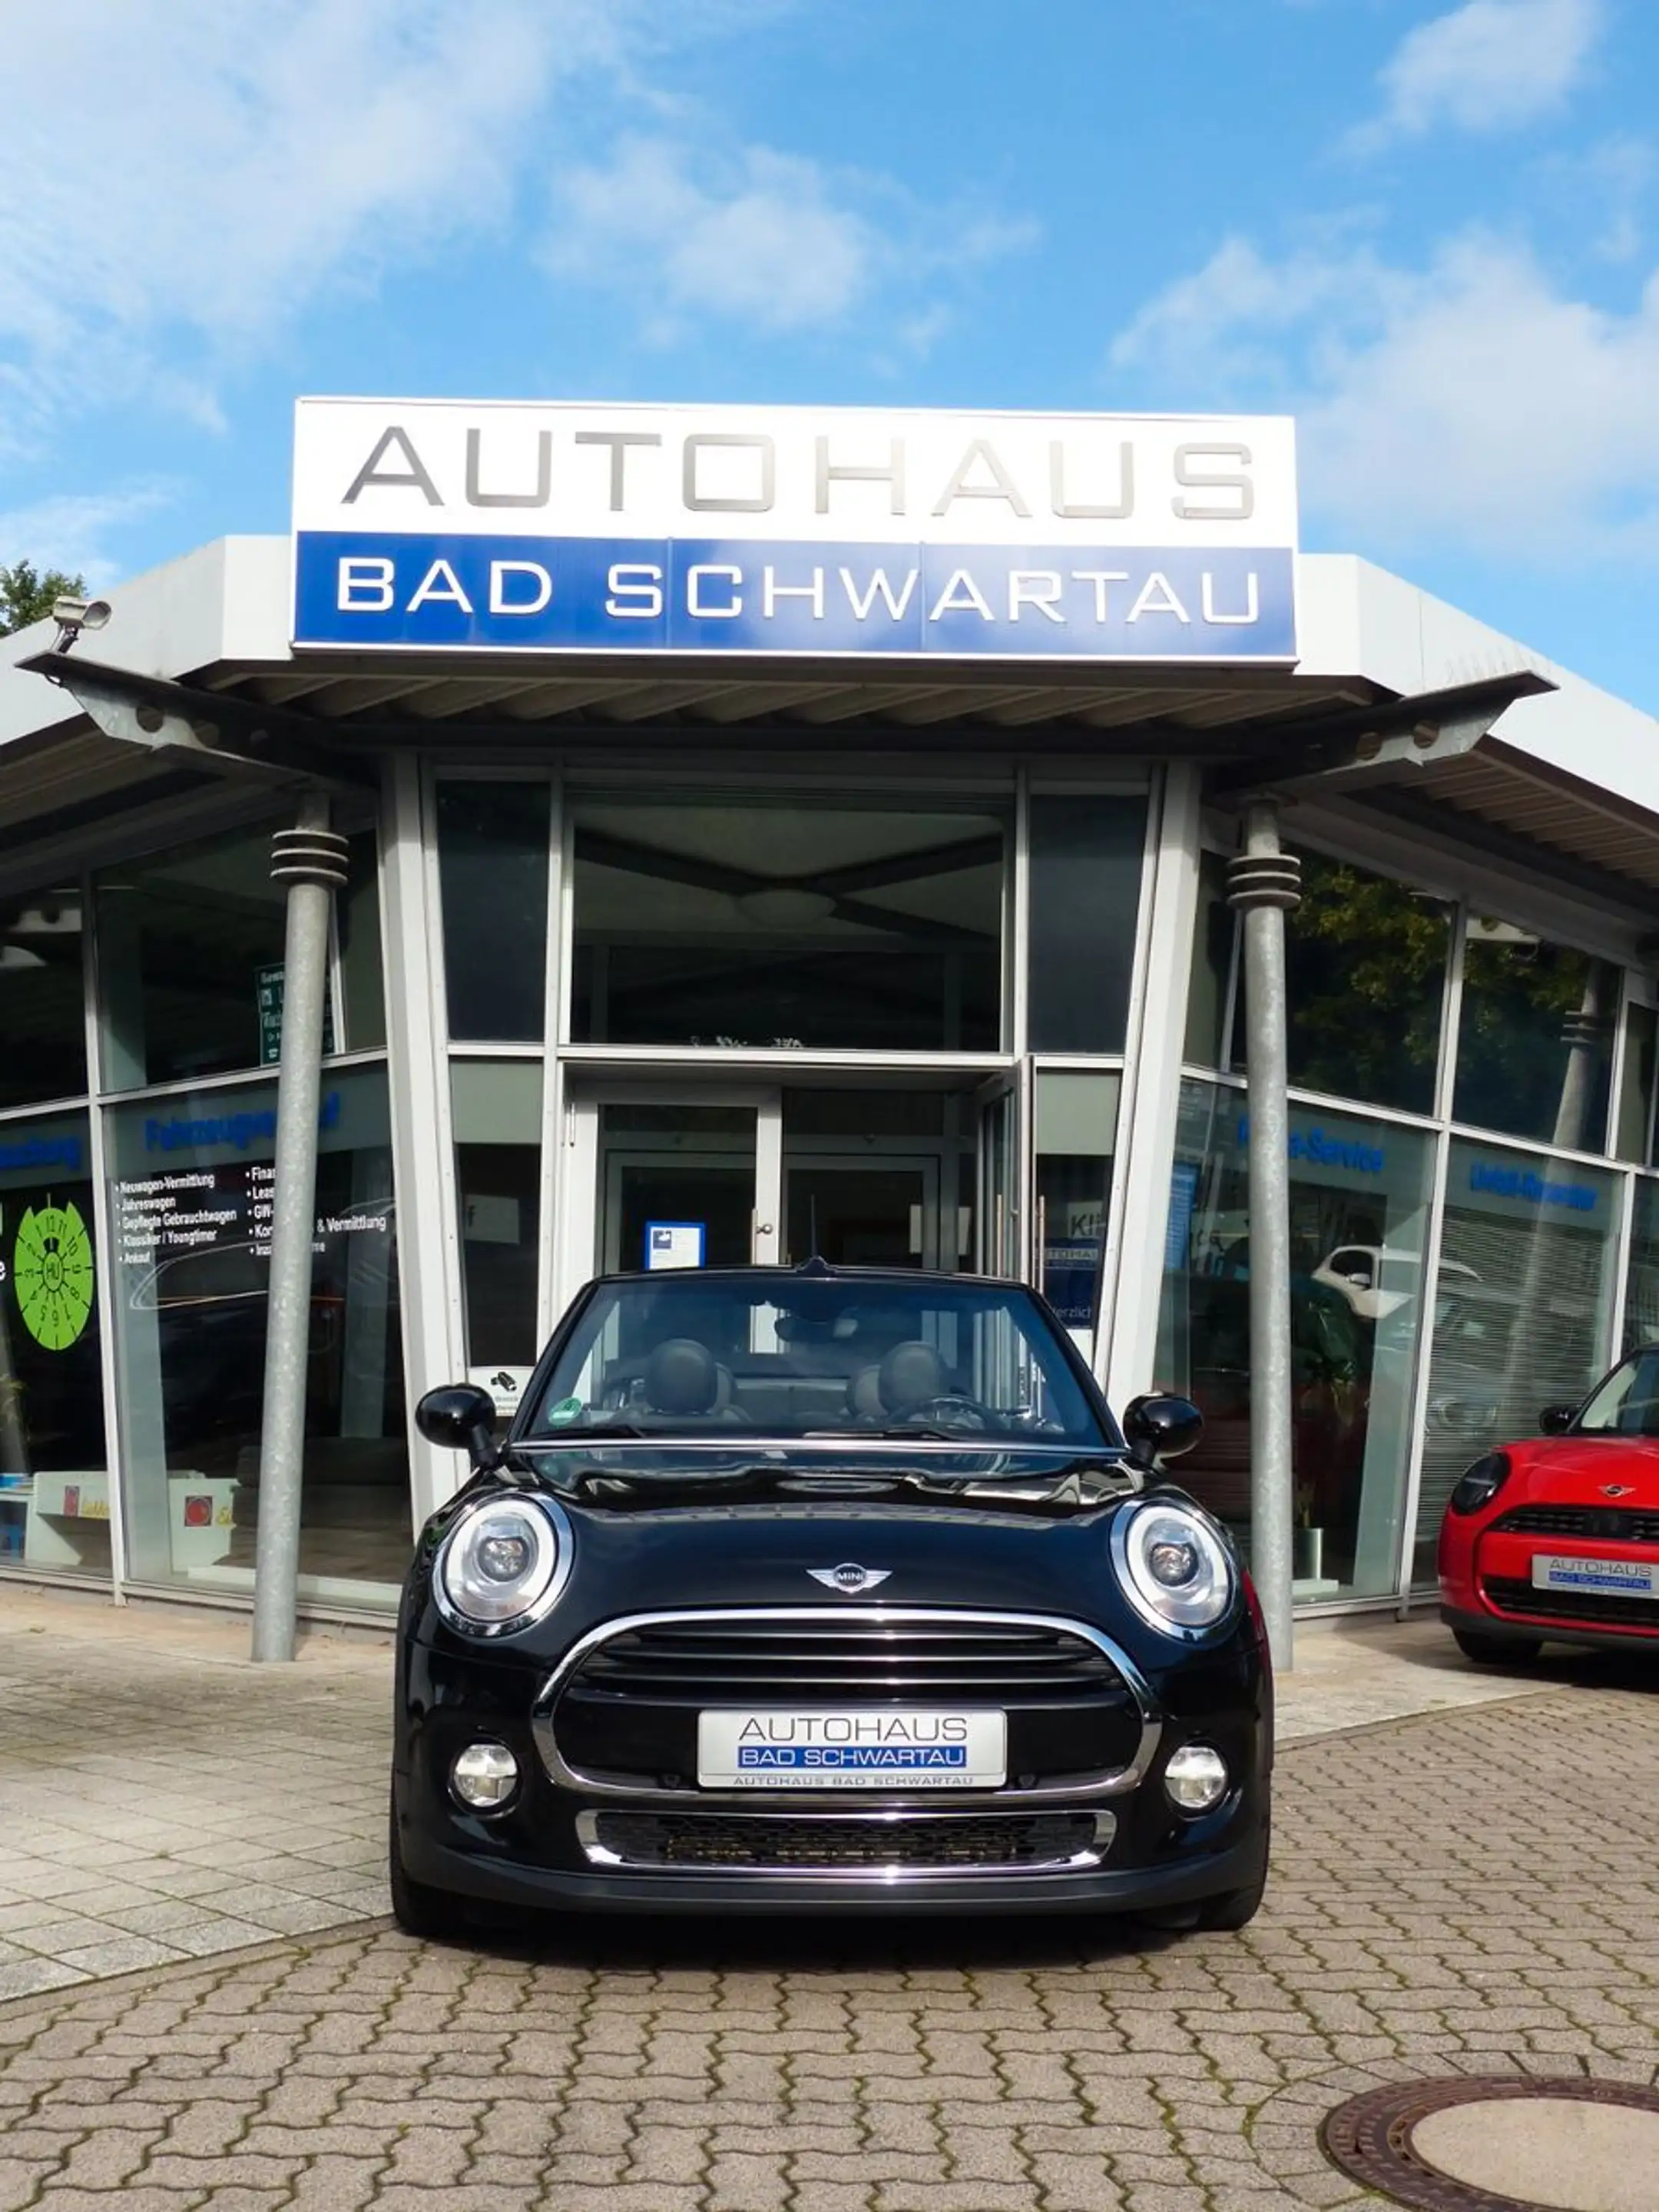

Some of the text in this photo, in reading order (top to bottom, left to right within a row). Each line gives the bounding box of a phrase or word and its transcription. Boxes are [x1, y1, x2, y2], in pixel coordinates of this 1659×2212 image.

[340, 426, 1254, 520] AUTOHAUS
[336, 556, 1259, 625] BAD SCHWARTAU
[120, 1174, 215, 1195] Neuwagen-Vermittlung
[122, 1197, 176, 1212] Jahreswagen
[45, 1214, 56, 1233] 12
[163, 1209, 237, 1226] Gebrauchtwagen
[326, 1214, 386, 1233] Vermittlung
[167, 1229, 217, 1246] Youngtimer
[837, 1571, 864, 1581] MINI
[1549, 1558, 1652, 1578] AUTOHAUS
[738, 1717, 968, 1742] AUTOHAUS
[741, 1748, 964, 1766] BAD SCHWARTAU
[733, 1777, 974, 1786] AUTOHAUS BAD SCHWARTAU
